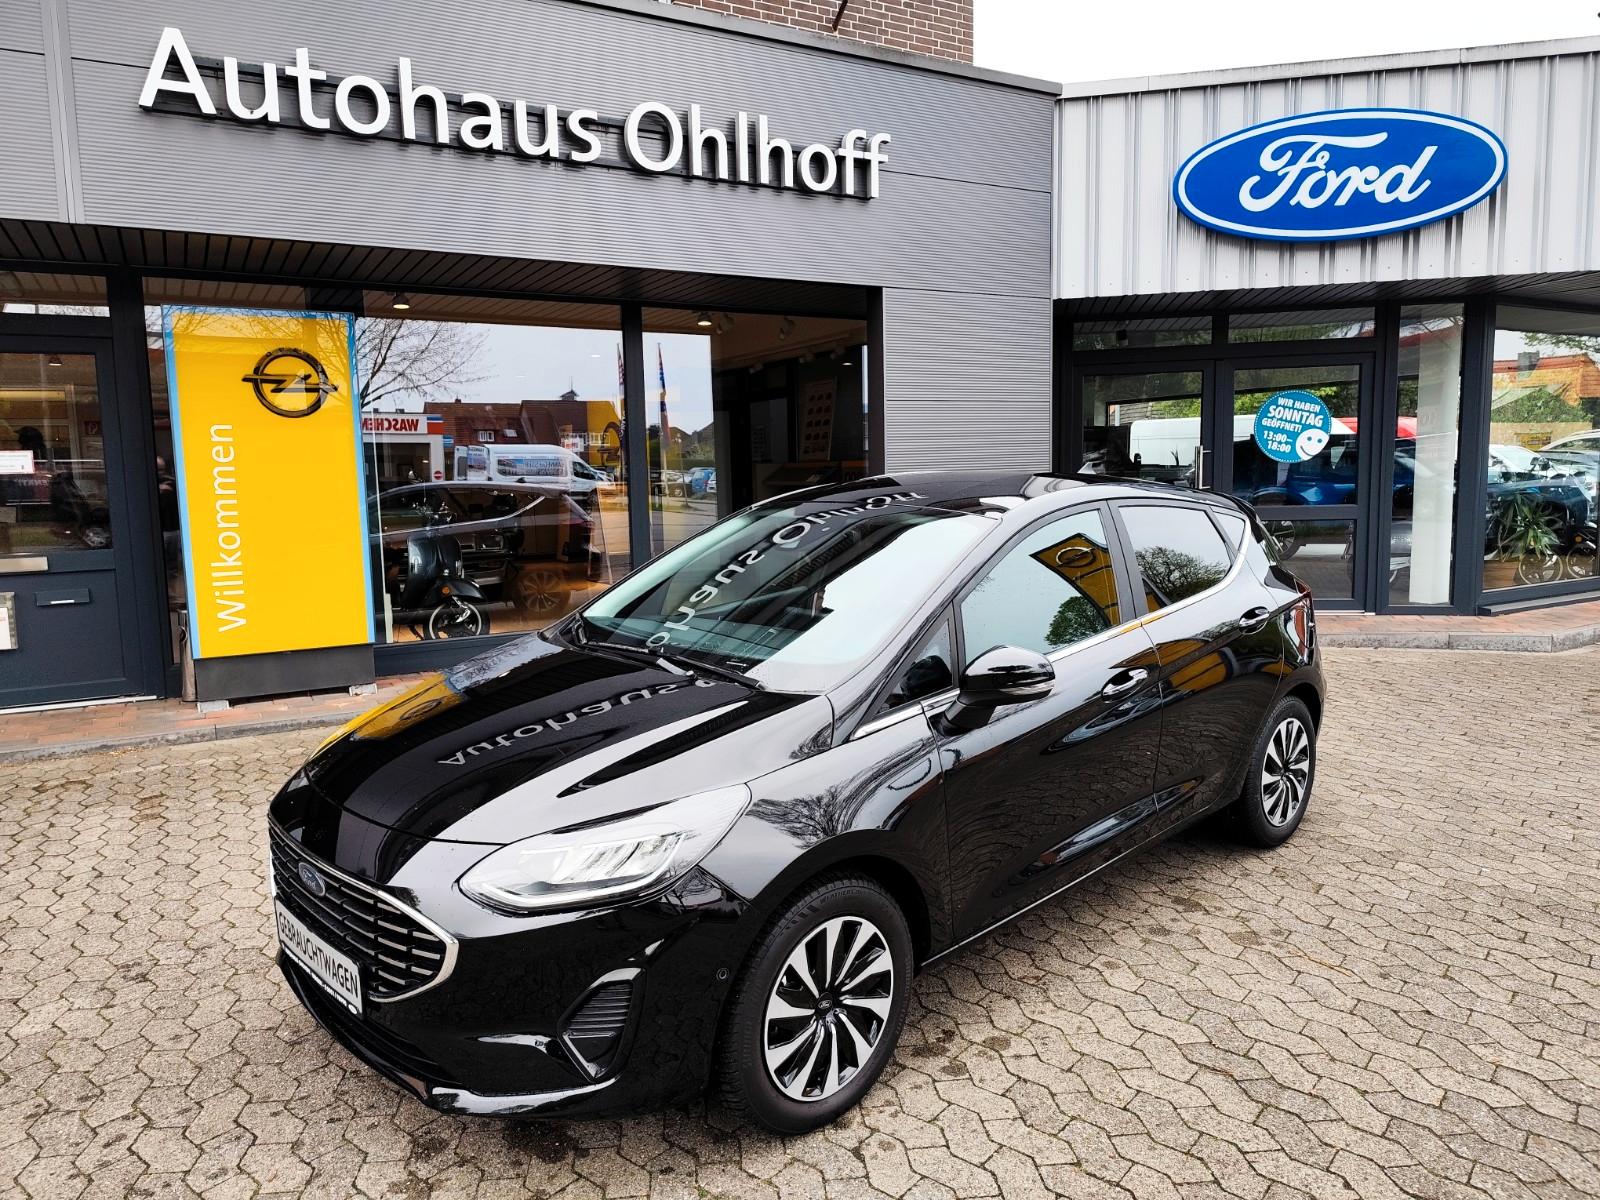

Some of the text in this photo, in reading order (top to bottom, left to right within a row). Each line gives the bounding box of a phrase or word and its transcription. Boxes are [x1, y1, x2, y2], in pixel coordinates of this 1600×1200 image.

[139, 27, 891, 198] Autohaus Ohlhoff
[1239, 132, 1438, 212] Ford
[1261, 417, 1303, 433] GEÖFFNET!
[1267, 405, 1324, 427] SONNTAG
[1278, 397, 1320, 412] WIR HABEN
[1267, 441, 1291, 453] 18:00
[209, 423, 247, 632] Willkommen
[278, 911, 359, 999] GEBRAUCHTWAGEN
